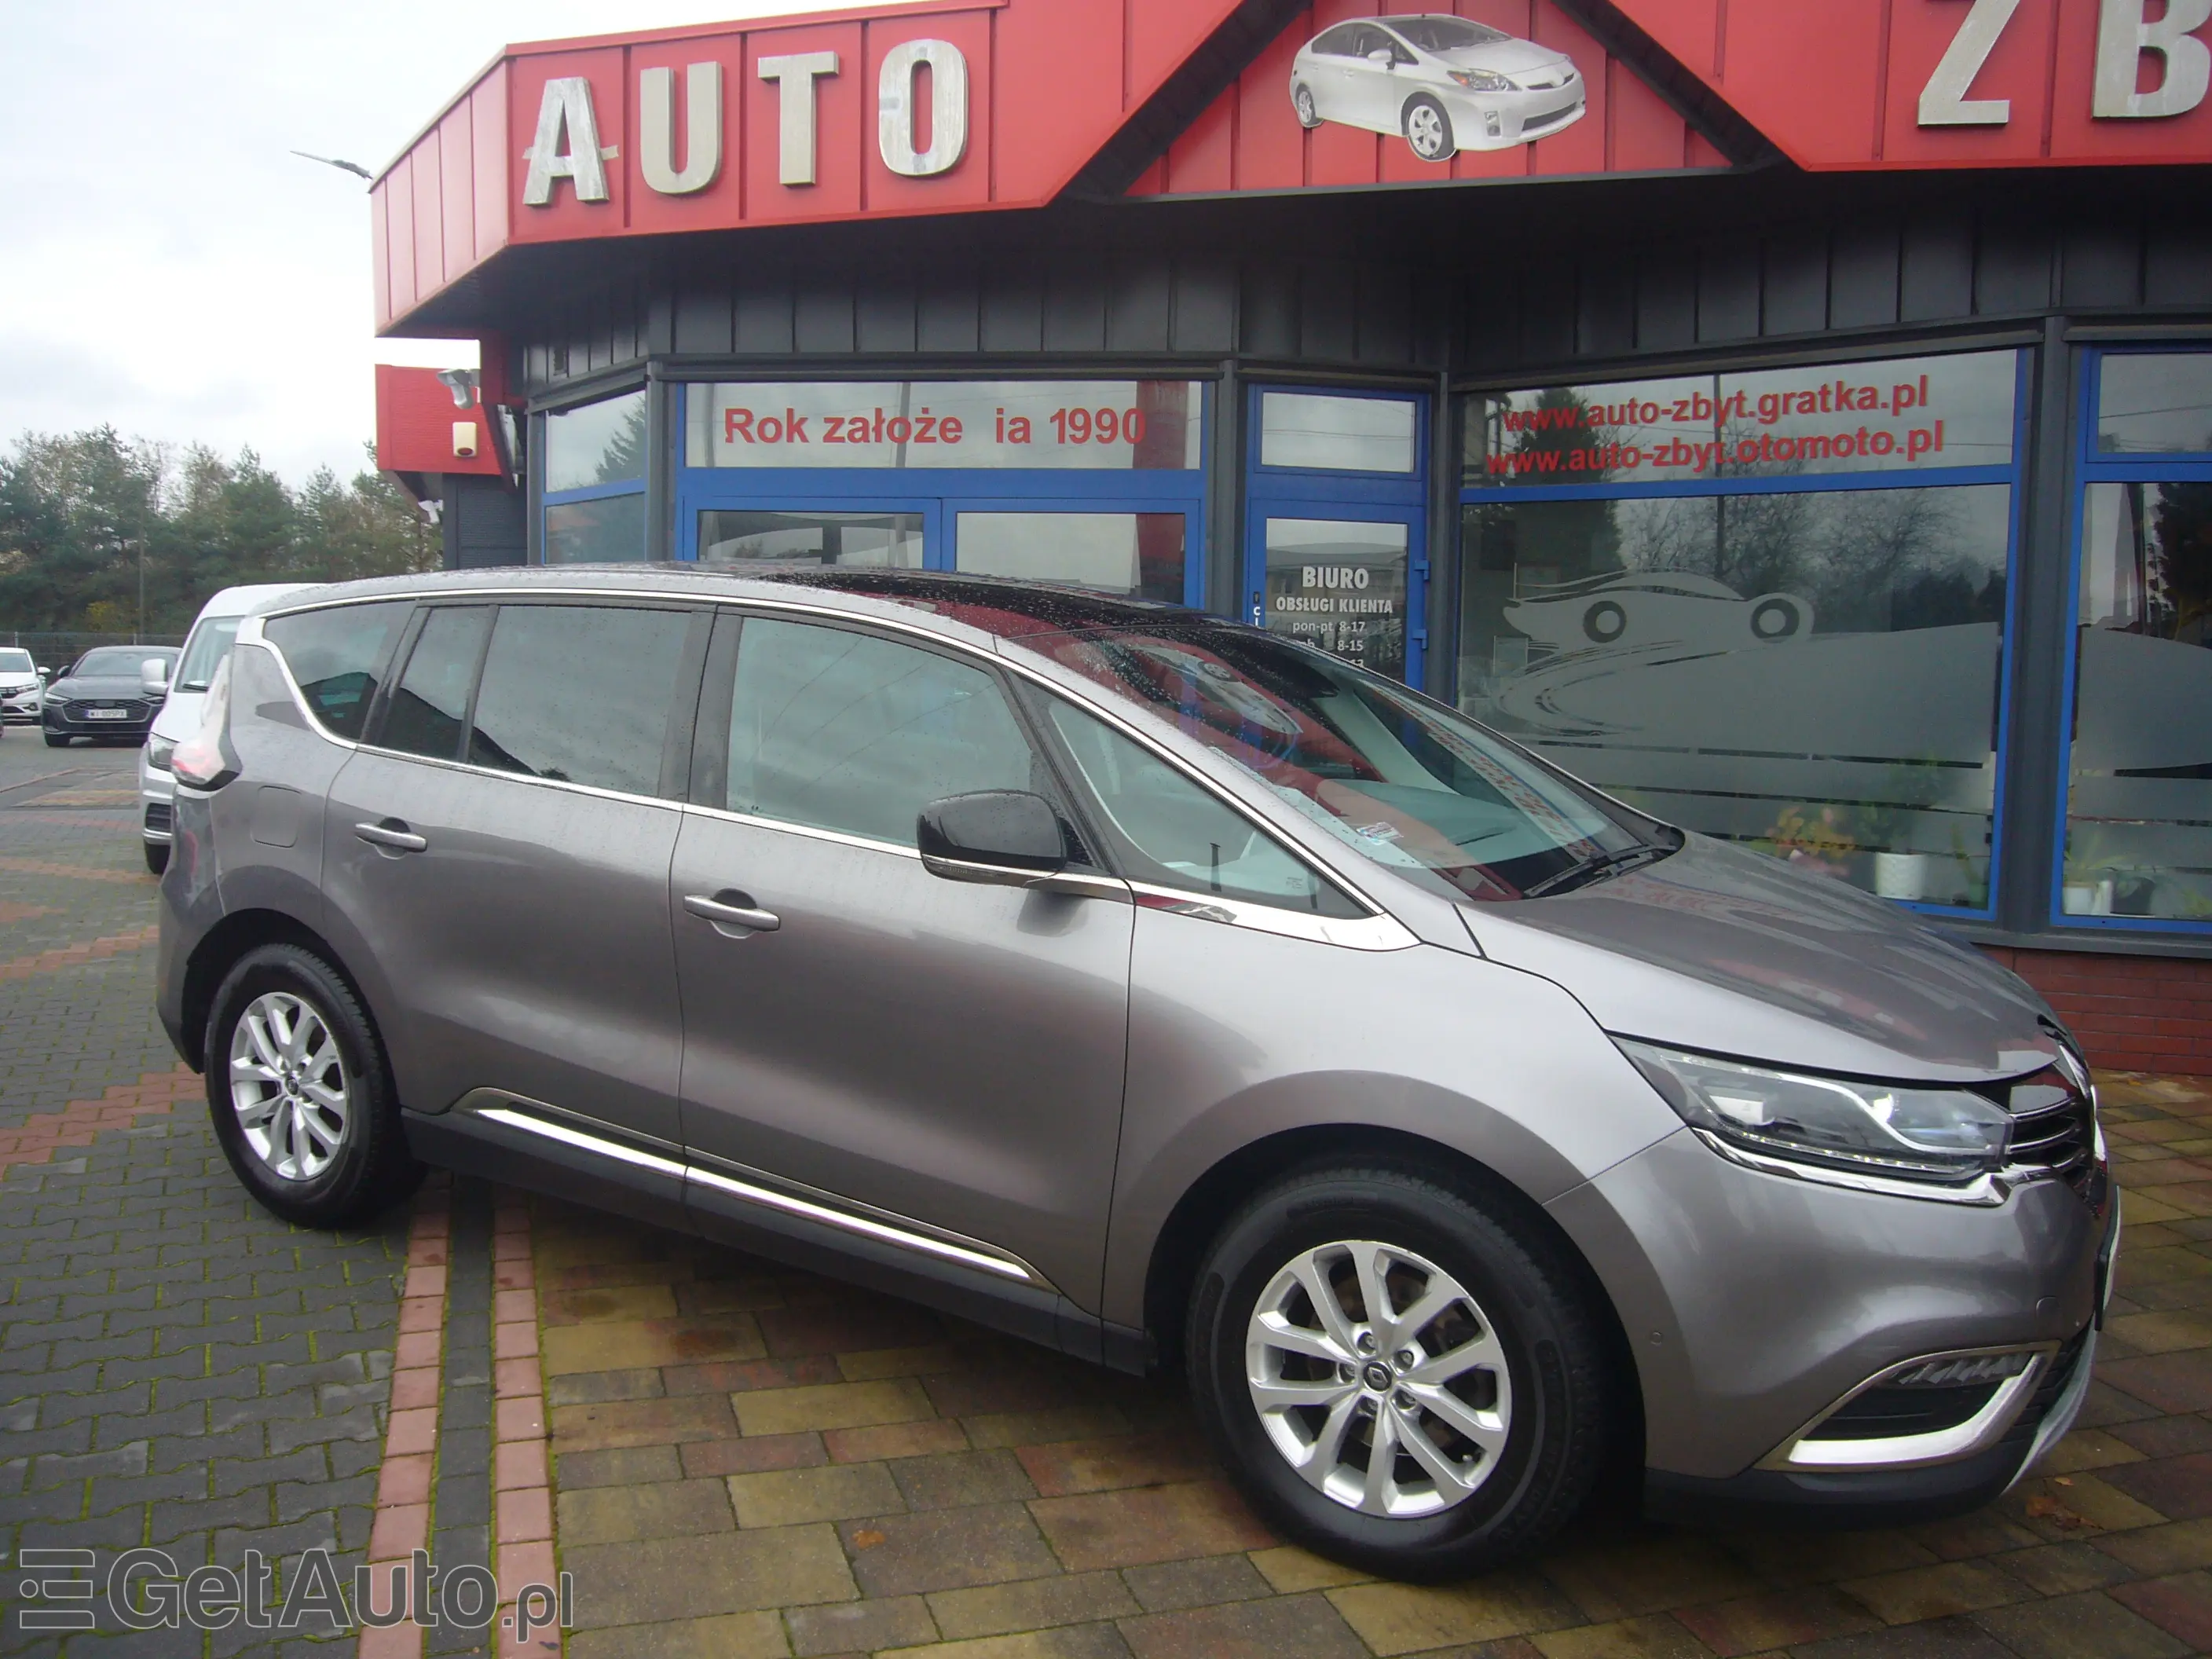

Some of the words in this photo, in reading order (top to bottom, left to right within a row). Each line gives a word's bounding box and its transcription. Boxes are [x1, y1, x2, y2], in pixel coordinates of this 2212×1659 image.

[522, 38, 969, 207] AUTO
[1501, 375, 1928, 431] www.auto-zbyt.gratka.pl
[725, 408, 808, 444] Rok
[1049, 407, 1147, 444] 1990
[1485, 419, 1944, 474] www.auto-zbyt.otomoto.pl
[1302, 566, 1369, 589] BIURO
[1276, 597, 1334, 612] OBSŁUGI
[1339, 599, 1393, 613] KLIENTA
[1293, 622, 1333, 634] pon-pt
[1339, 621, 1366, 632] 8-17
[1337, 640, 1364, 651] 8-15
